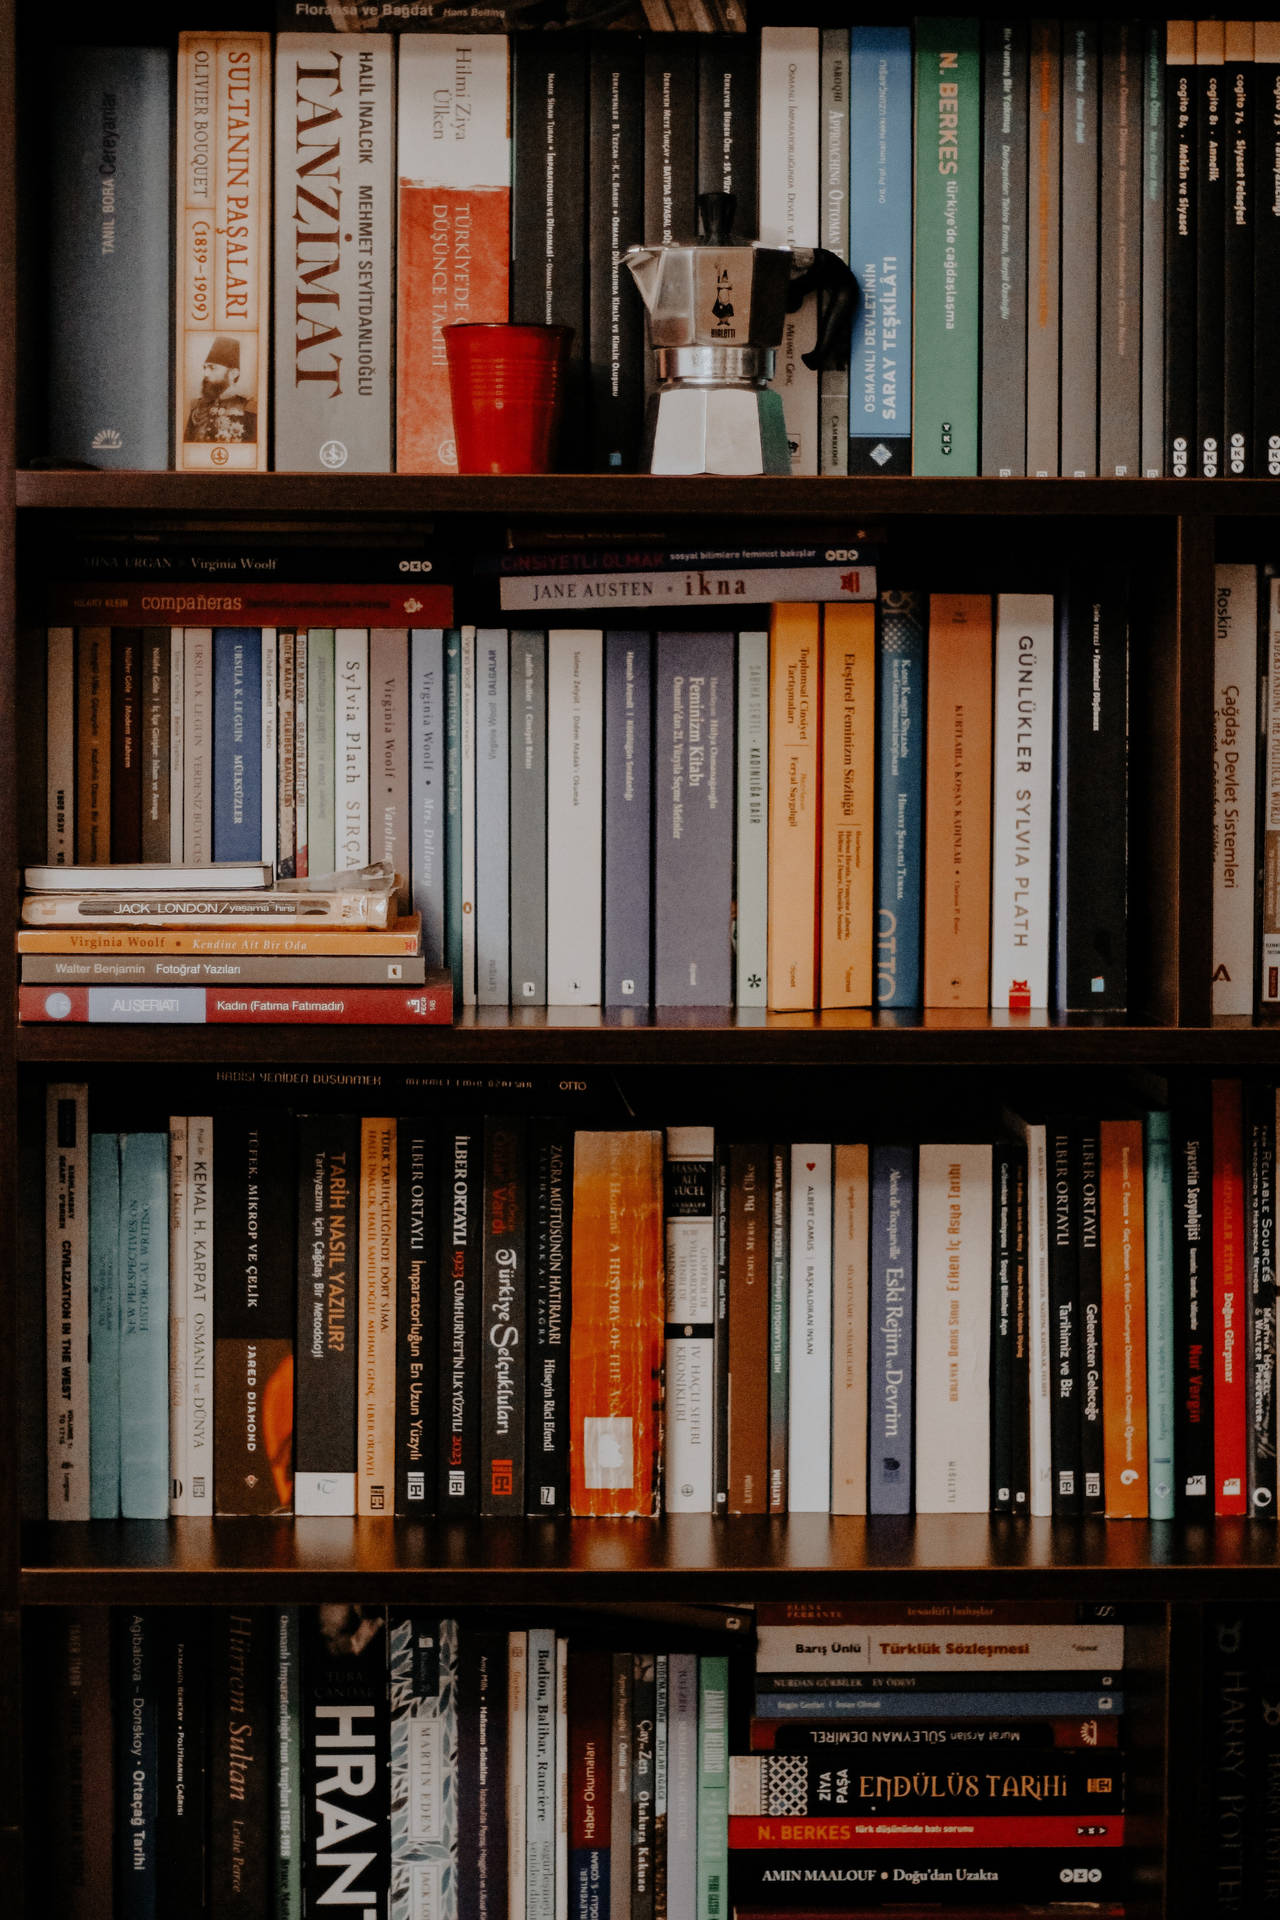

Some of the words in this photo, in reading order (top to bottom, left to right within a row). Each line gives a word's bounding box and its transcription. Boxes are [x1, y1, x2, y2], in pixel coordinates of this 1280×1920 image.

[194, 51, 210, 117] OLIVIER
[359, 51, 376, 96] HALİL
[455, 47, 473, 97] Hilmi
[938, 53, 958, 74] N.
[433, 89, 453, 139] Ülken
[1177, 78, 1188, 112] cogito
[1234, 74, 1245, 108] cogito
[227, 51, 251, 188] SULTANIN
[359, 101, 376, 164] İNALCIK
[452, 104, 472, 141] Ziya
[939, 83, 958, 175] BERKES
[1178, 115, 1189, 128] 84
[1235, 111, 1244, 124] 74
[191, 120, 209, 198] BOUQUET
[1179, 144, 1189, 179] Mekân
[1235, 140, 1246, 178] Siyaset
[946, 181, 958, 244] türkiye'de
[1179, 182, 1187, 195] ve
[1235, 180, 1246, 225] Felsefesi
[292, 50, 352, 398] TANZİMAT
[359, 186, 373, 255] MEHMET
[1177, 198, 1188, 235] Siyaset
[216, 195, 249, 319] PAŞALARI
[432, 205, 450, 296] DÜŞÜNCE
[454, 204, 472, 310] TÜRKİYE'DE
[862, 264, 876, 345] DEVLETİNİN
[880, 257, 897, 350] TEŞKİLÂTI
[944, 247, 957, 329] çağdaşlaşma
[358, 261, 373, 396] SEYİTDANLIOĞLU
[864, 350, 875, 412] OSMANLI
[882, 357, 896, 419] SARAY
[192, 559, 236, 571] Virginia
[241, 558, 276, 569] Woolf
[533, 584, 577, 601] JANE
[583, 581, 654, 597] AUSTEN
[685, 572, 746, 596] ikna
[142, 597, 242, 612] compañeras
[1215, 588, 1231, 638] Roskin
[342, 661, 360, 721] Sylvia
[787, 663, 797, 723] Tartışmaları
[800, 646, 810, 698] Toplumsal
[843, 653, 856, 702] Eleştirel
[422, 672, 433, 725] Virginia
[689, 677, 704, 742] Feminizm
[800, 700, 808, 739] Cinsiyet
[1017, 636, 1037, 773] GÜNLÜKLER
[1221, 685, 1239, 746] Çağdaş
[346, 733, 361, 784] Plath
[424, 732, 433, 770] Woolf
[844, 706, 855, 765] Feminizm
[689, 746, 704, 786] Kitabı
[1224, 752, 1239, 803] Devlet
[424, 798, 434, 824] Mrs.
[842, 769, 854, 816] Sözlüğü
[342, 801, 361, 867] SIRÇA
[1016, 790, 1031, 866] SYLVIA
[1224, 809, 1238, 888] Sistemleri
[420, 829, 434, 889] Dalloway
[1014, 877, 1029, 946] PLATH
[56, 964, 91, 973] Walter
[94, 963, 145, 974] Benjamin
[156, 964, 201, 976] Fotoğraf
[203, 964, 240, 974] Yazıları
[559, 1081, 587, 1090] OTTO
[330, 1154, 348, 1208] TARİH
[412, 1140, 424, 1180] İLBER
[455, 1136, 468, 1178] İLBER
[1187, 1142, 1199, 1185] Siyasetin
[194, 1162, 207, 1214] KEMAL
[315, 1153, 325, 1212] Tarihyazımı
[194, 1221, 206, 1234] H.
[312, 1217, 324, 1236] için
[411, 1185, 423, 1249] ORTAYLI
[453, 1182, 467, 1245] ORTAYLI
[1185, 1188, 1201, 1240] Sosyolojisi
[312, 1241, 325, 1278] Çağdaş
[329, 1215, 345, 1268] NASIL
[452, 1251, 466, 1278] 1923
[62, 1240, 71, 1321] CIVILIZATION
[194, 1241, 206, 1301] KARPAT
[314, 1283, 324, 1297] Bir
[493, 1249, 516, 1321] Türkiye
[886, 1268, 905, 1302] Eski
[62, 1323, 71, 1335] IN
[312, 1302, 323, 1357] Metodoloji
[328, 1272, 345, 1351] YAZILIR?
[408, 1260, 426, 1357] İmparatorluğun
[453, 1280, 467, 1368] CUMHURİYET'İN
[882, 1306, 903, 1357] Rejim
[1222, 1293, 1234, 1328] Doğan
[62, 1339, 71, 1362] THE
[194, 1313, 205, 1379] OSMANLI
[248, 1346, 256, 1386] JARED
[410, 1363, 423, 1378] En
[886, 1360, 892, 1368] ve
[1189, 1345, 1202, 1369] Nur
[1223, 1329, 1234, 1383] Gürpınar
[62, 1367, 71, 1400] WEST
[194, 1384, 200, 1393] ve
[410, 1383, 422, 1415] Uzun
[453, 1371, 464, 1388] İLK
[490, 1324, 518, 1434] Selçukluları
[542, 1360, 555, 1398] Hüseyin
[885, 1370, 903, 1437] Devrim
[1187, 1376, 1202, 1422] Vergin
[194, 1398, 205, 1448] DÜNYA
[247, 1392, 256, 1451] DIAMOND
[452, 1391, 464, 1432] YÜZYILI
[544, 1400, 555, 1419] Râci
[408, 1420, 422, 1460] Yüzyılı
[450, 1436, 462, 1465] 2023
[544, 1422, 555, 1451] Efendi
[131, 1616, 143, 1681] Agibalova
[230, 1616, 250, 1712] Hürrem
[796, 1644, 827, 1655] Barış
[831, 1643, 861, 1653] Ünlü
[879, 1643, 941, 1654] Türklük
[946, 1643, 1030, 1656] Sözleşmesi
[537, 1650, 550, 1700] Badiou,
[132, 1698, 144, 1755] Donskoy
[538, 1705, 549, 1757] Balibar,
[811, 1731, 868, 1743] DEMİREL
[872, 1731, 946, 1742] SÜLEYMAN
[950, 1732, 984, 1740] Arslan
[989, 1732, 1020, 1740] Murat
[229, 1722, 252, 1800] Sultan
[421, 1727, 431, 1786] MARTIN
[584, 1743, 595, 1801] Okumaları
[131, 1770, 145, 1826] Ortaçağ
[538, 1762, 548, 1821] Rancière
[817, 1772, 831, 1800] ZİYA
[836, 1769, 849, 1803] PAŞA
[315, 1706, 379, 1920] HRAN
[421, 1793, 431, 1832] EDEN
[584, 1804, 595, 1838] Haber
[636, 1791, 650, 1843] Okakura
[758, 1826, 775, 1840] N.
[781, 1825, 850, 1840] BERKES
[855, 1825, 874, 1833] türk
[875, 1825, 923, 1833] düşününde
[923, 1825, 942, 1833] batı
[134, 1831, 145, 1870] Tarihi
[638, 1847, 648, 1892] Kakuzo
[763, 1870, 801, 1881] AMIN
[805, 1870, 876, 1881] MAALOUF
[893, 1869, 953, 1884] Doğu'dan
[956, 1869, 998, 1880] Uzakta
